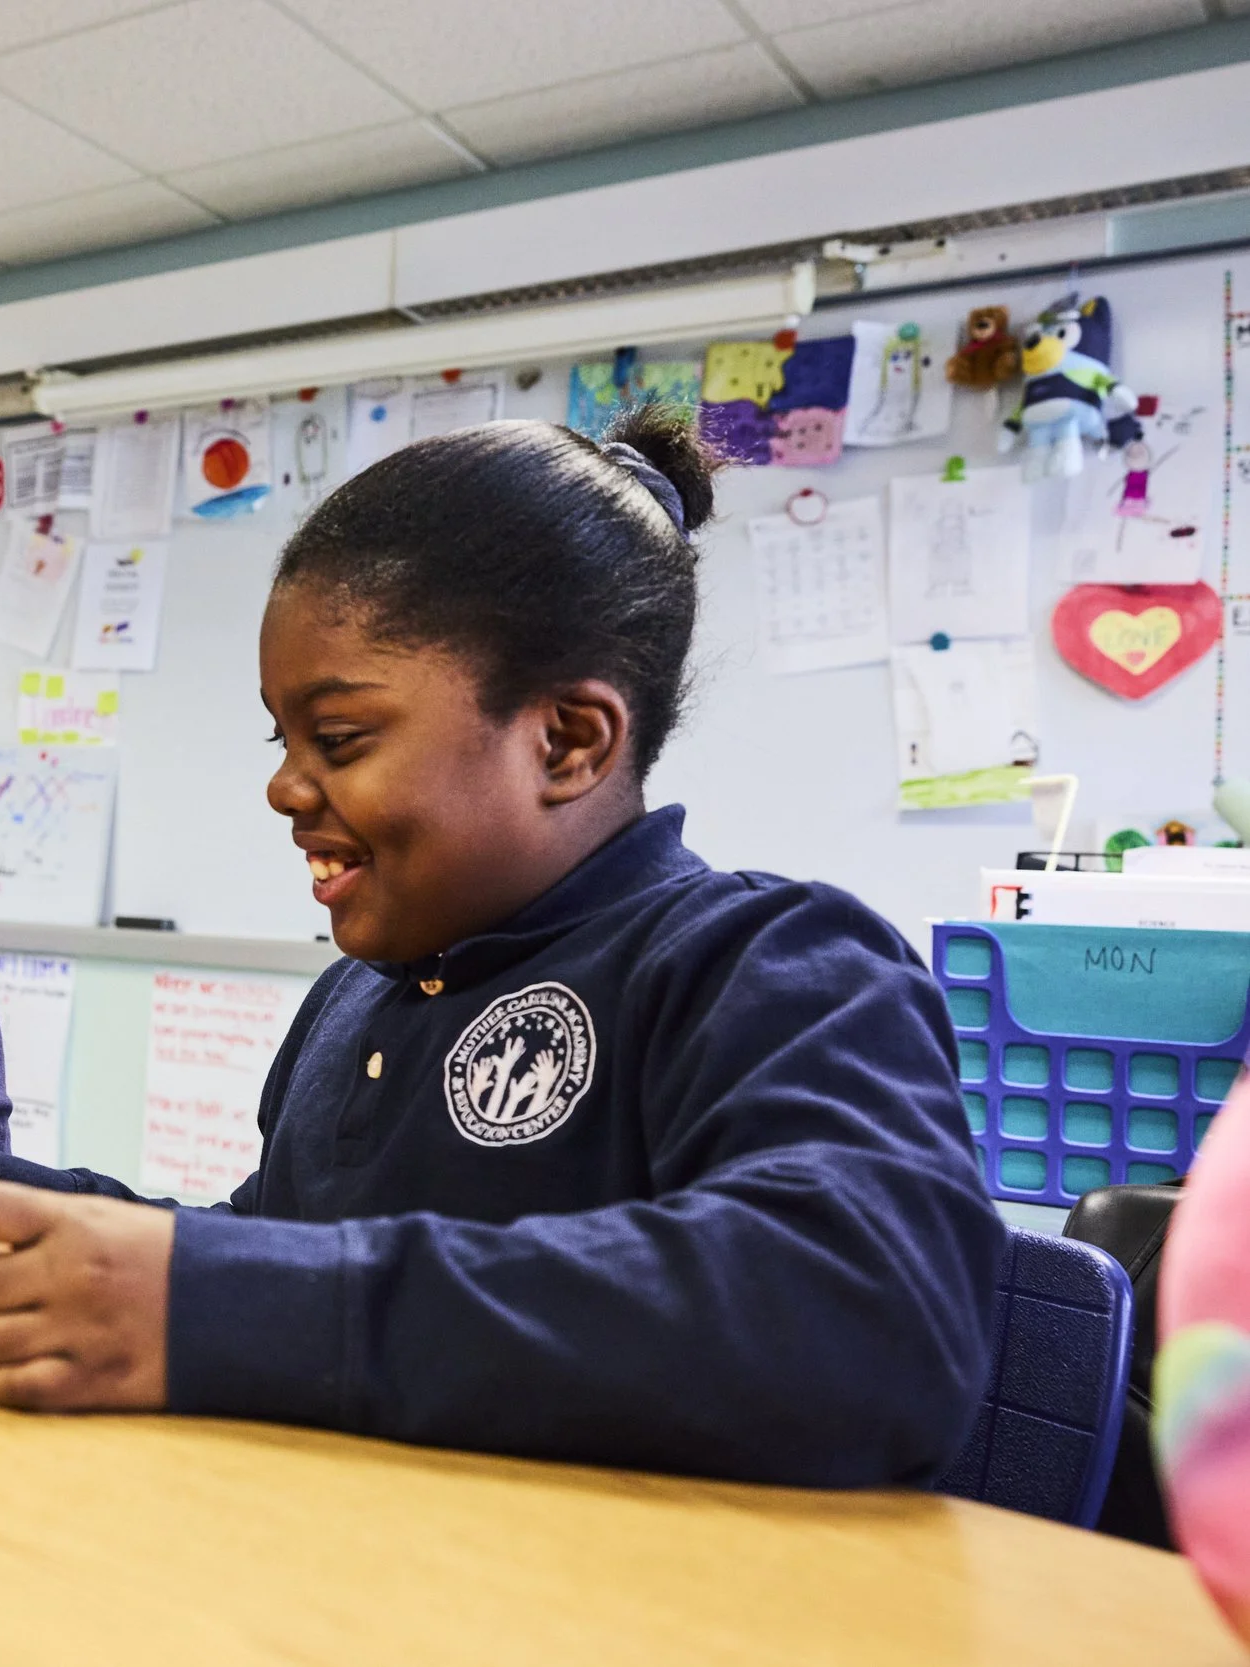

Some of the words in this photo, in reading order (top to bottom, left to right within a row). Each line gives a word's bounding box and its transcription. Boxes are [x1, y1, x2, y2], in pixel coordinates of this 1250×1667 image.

[1084, 945, 1157, 975] MON
[454, 1006, 507, 1065] MOTHER
[511, 1095, 568, 1138] CENTER
